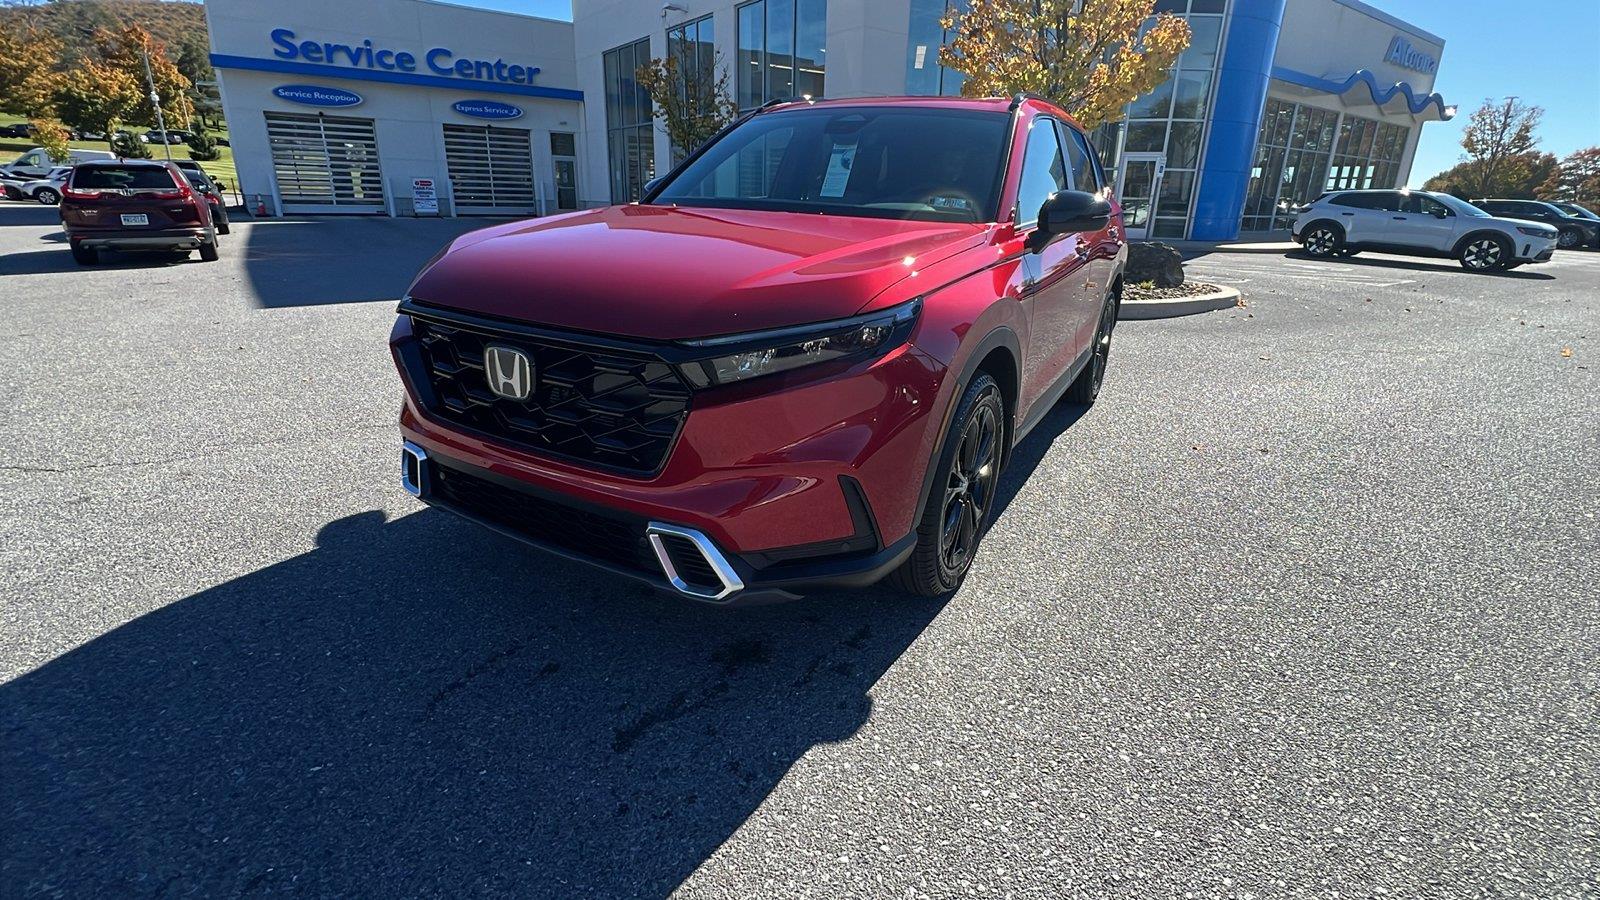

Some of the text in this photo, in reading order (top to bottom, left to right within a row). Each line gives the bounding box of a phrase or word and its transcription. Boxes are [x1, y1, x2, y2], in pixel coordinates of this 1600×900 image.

[270, 28, 541, 84] Service Center
[278, 88, 357, 102] Service Reception
[455, 103, 509, 114] Express Service
